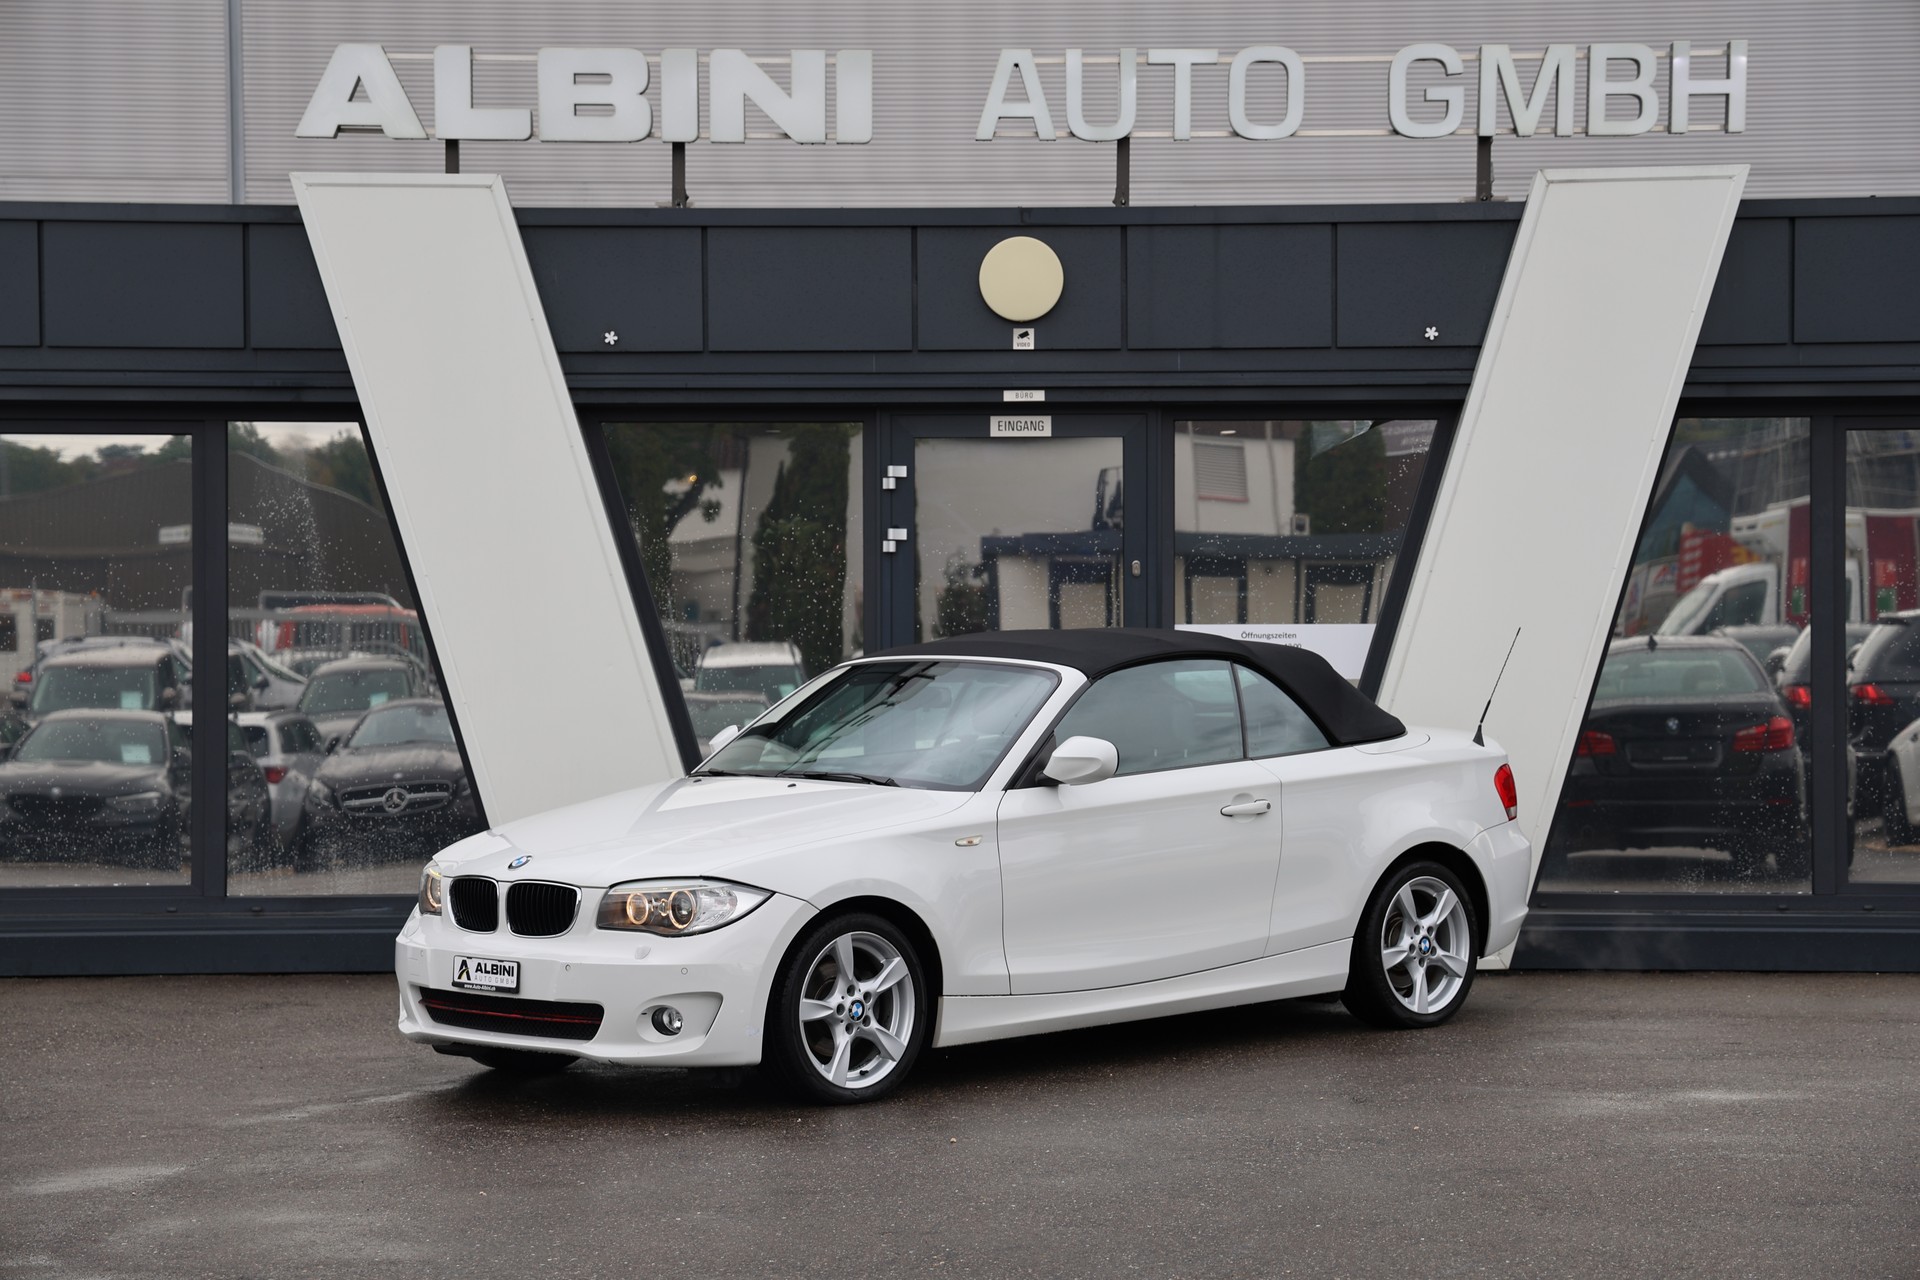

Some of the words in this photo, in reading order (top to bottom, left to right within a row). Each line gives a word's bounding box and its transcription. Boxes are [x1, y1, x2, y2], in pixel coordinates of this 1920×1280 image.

[295, 43, 873, 145] ALBINI
[975, 46, 1304, 142] AUTO
[1388, 40, 1748, 138] GMBH
[1015, 391, 1034, 399] BÜRO
[997, 420, 1044, 431] EINGANG
[1241, 631, 1296, 639] Öffnungszeiten
[475, 962, 514, 977] ALBINI
